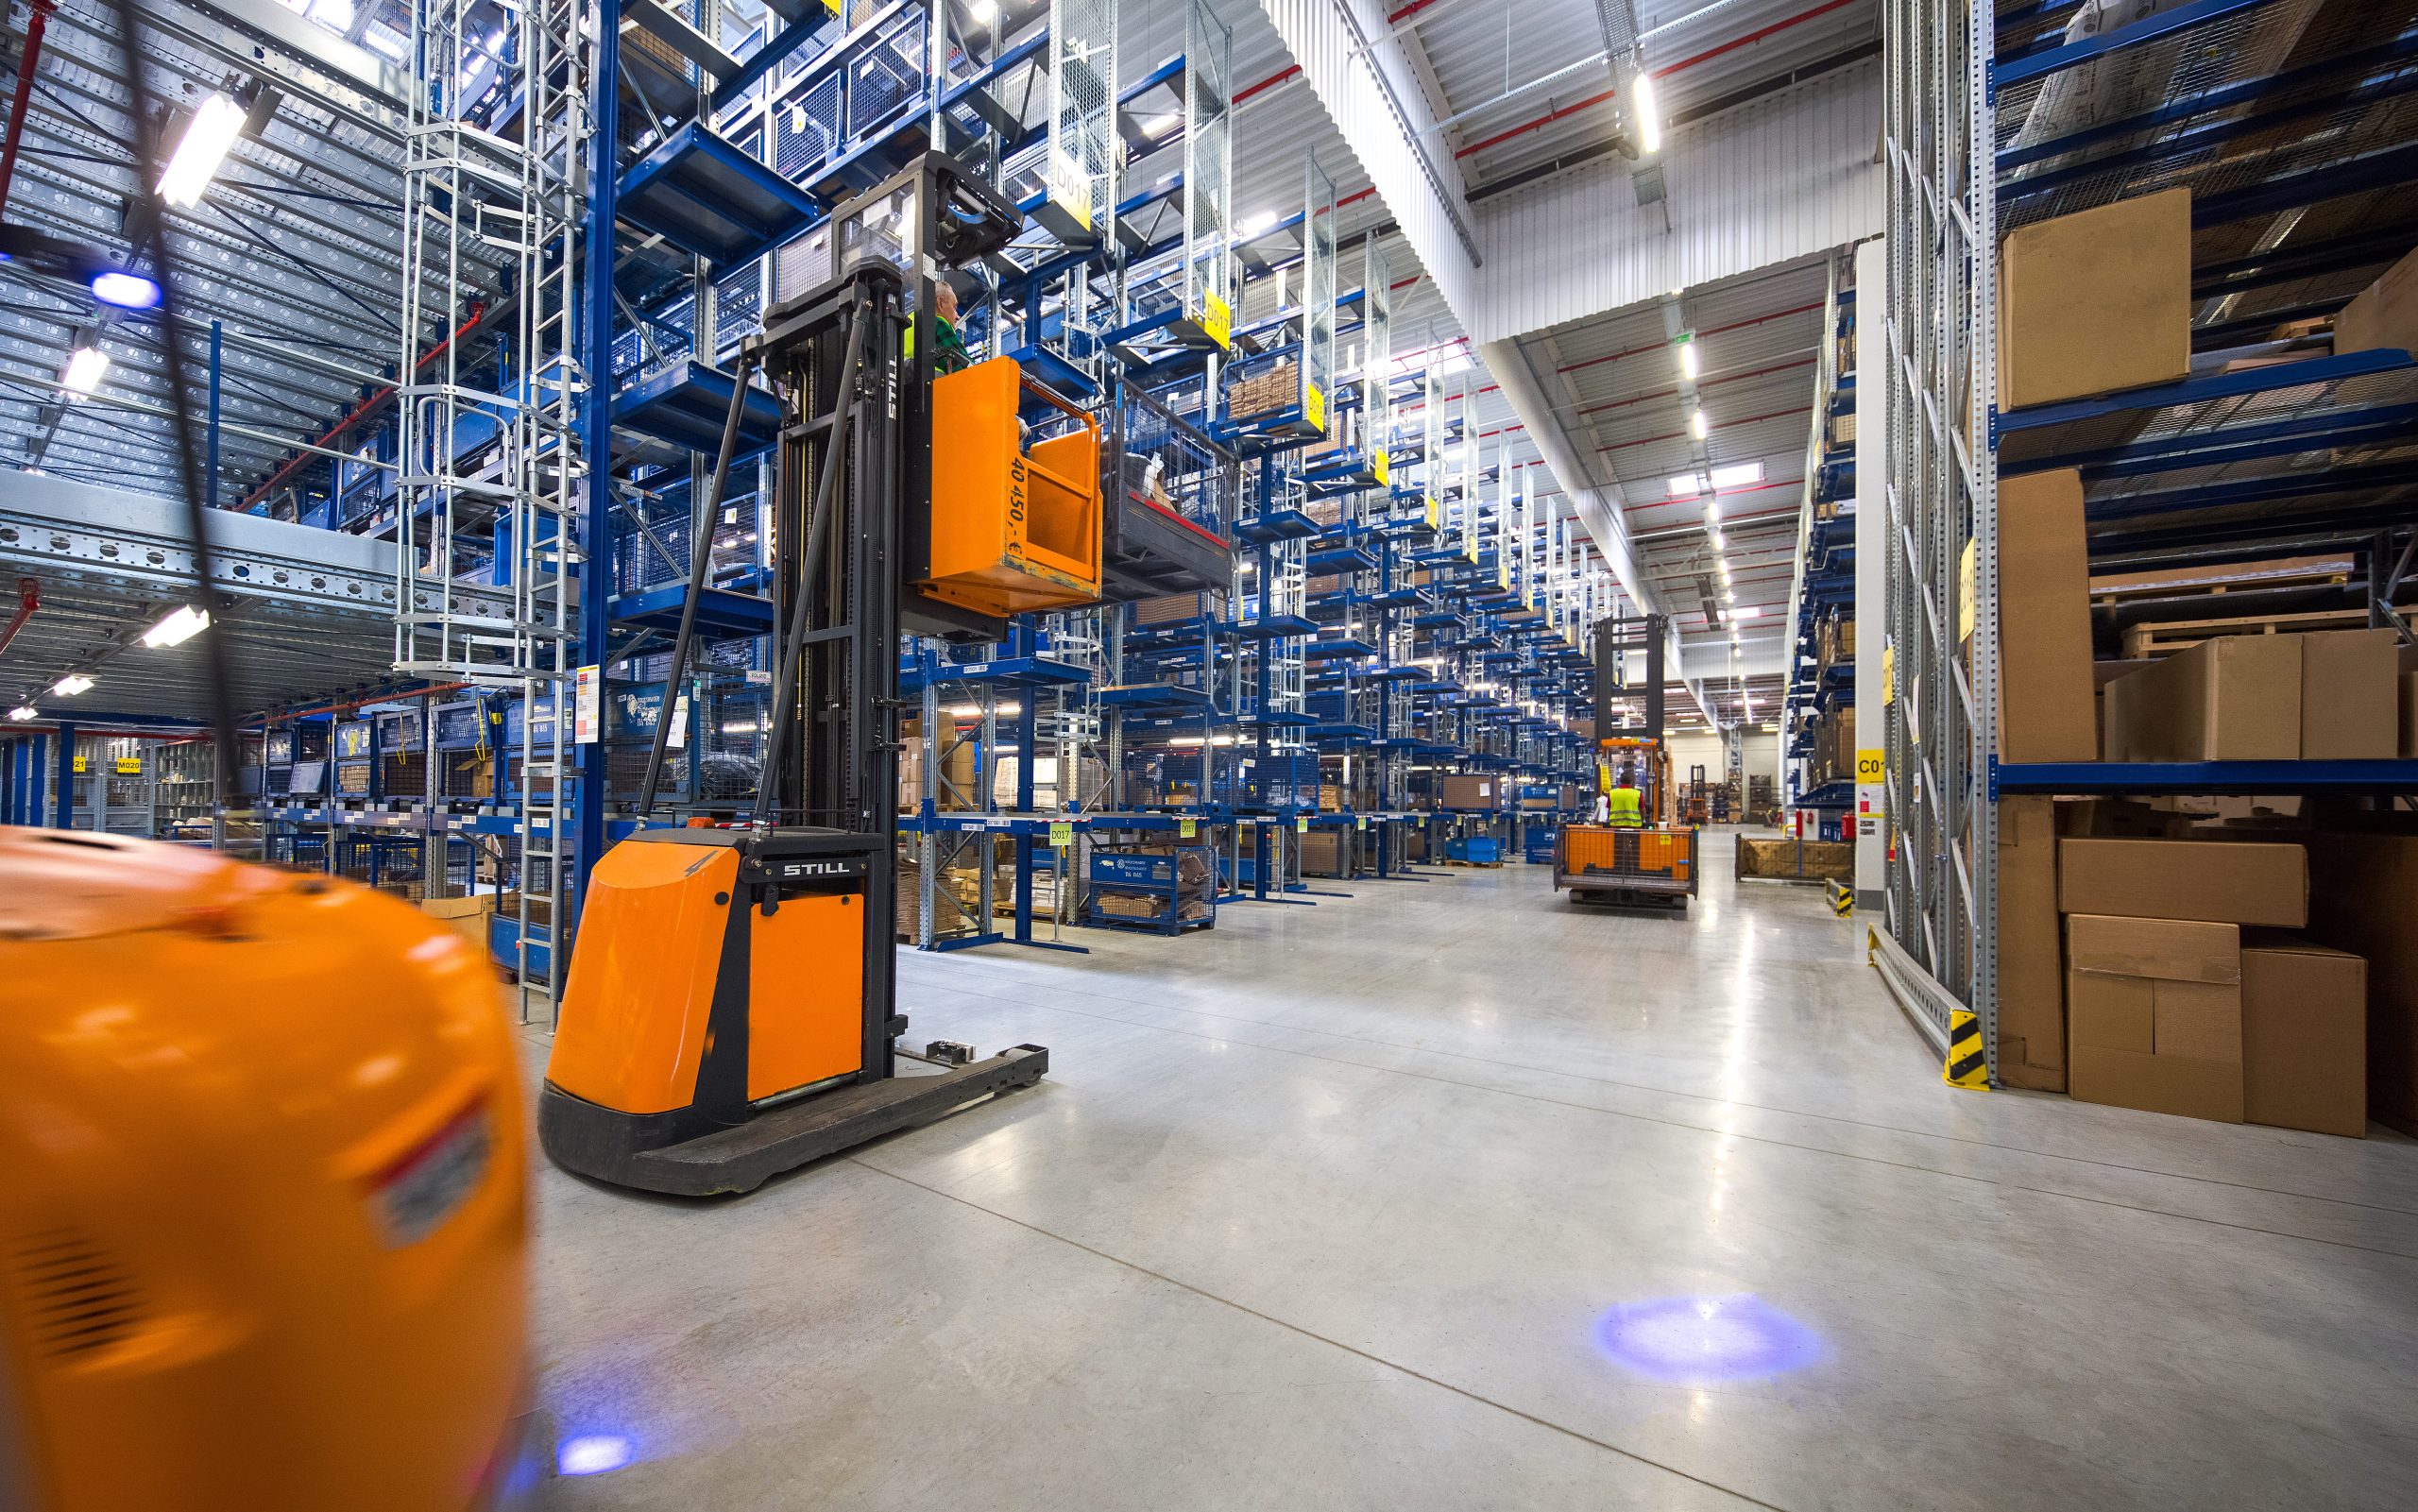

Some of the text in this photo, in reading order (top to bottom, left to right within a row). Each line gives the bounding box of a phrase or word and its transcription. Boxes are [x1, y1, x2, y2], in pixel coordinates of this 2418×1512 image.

[1057, 163, 1089, 208] D017
[1207, 303, 1229, 333] D017
[888, 354, 897, 420] STILL
[1859, 759, 1884, 773] C0
[1051, 830, 1070, 840] D017
[1182, 824, 1195, 833] D017
[784, 862, 850, 876] STILL
